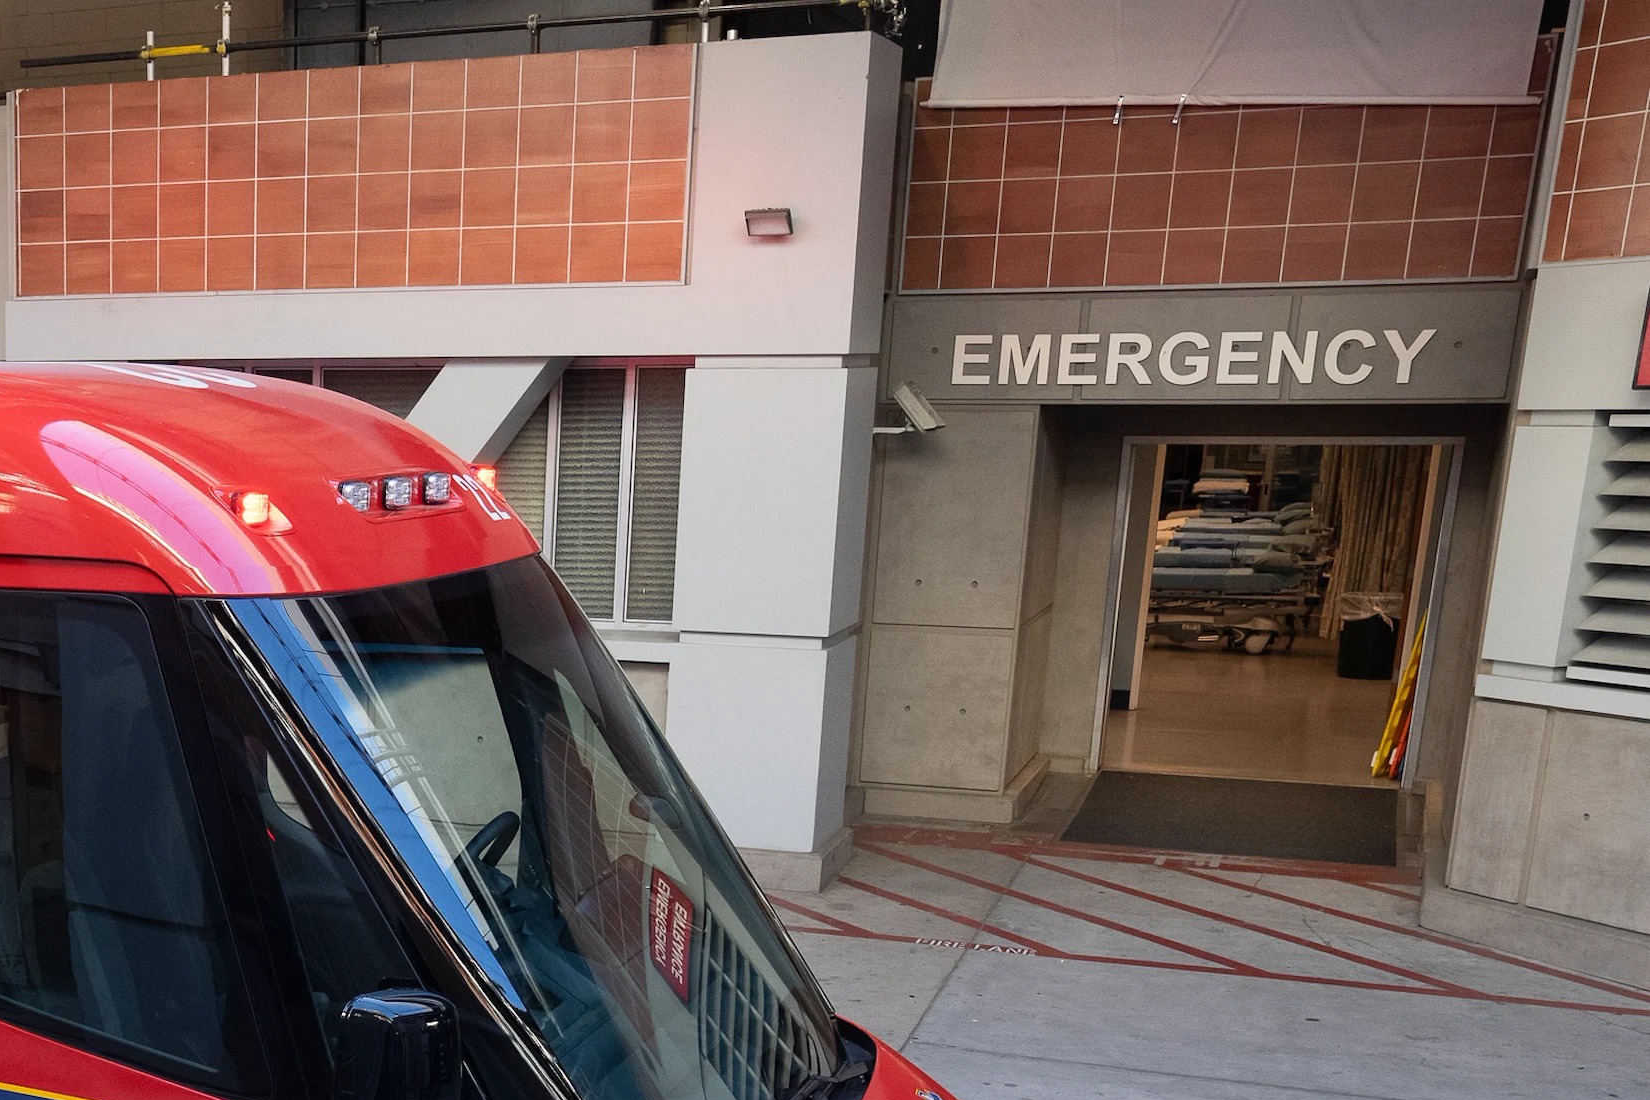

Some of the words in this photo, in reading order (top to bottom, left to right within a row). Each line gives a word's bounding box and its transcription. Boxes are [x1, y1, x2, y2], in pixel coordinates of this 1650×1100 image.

[951, 329, 1437, 386] EMERGENCY
[451, 474, 512, 521] 22
[915, 938, 967, 949] FIRE
[973, 943, 1037, 956] LANE
